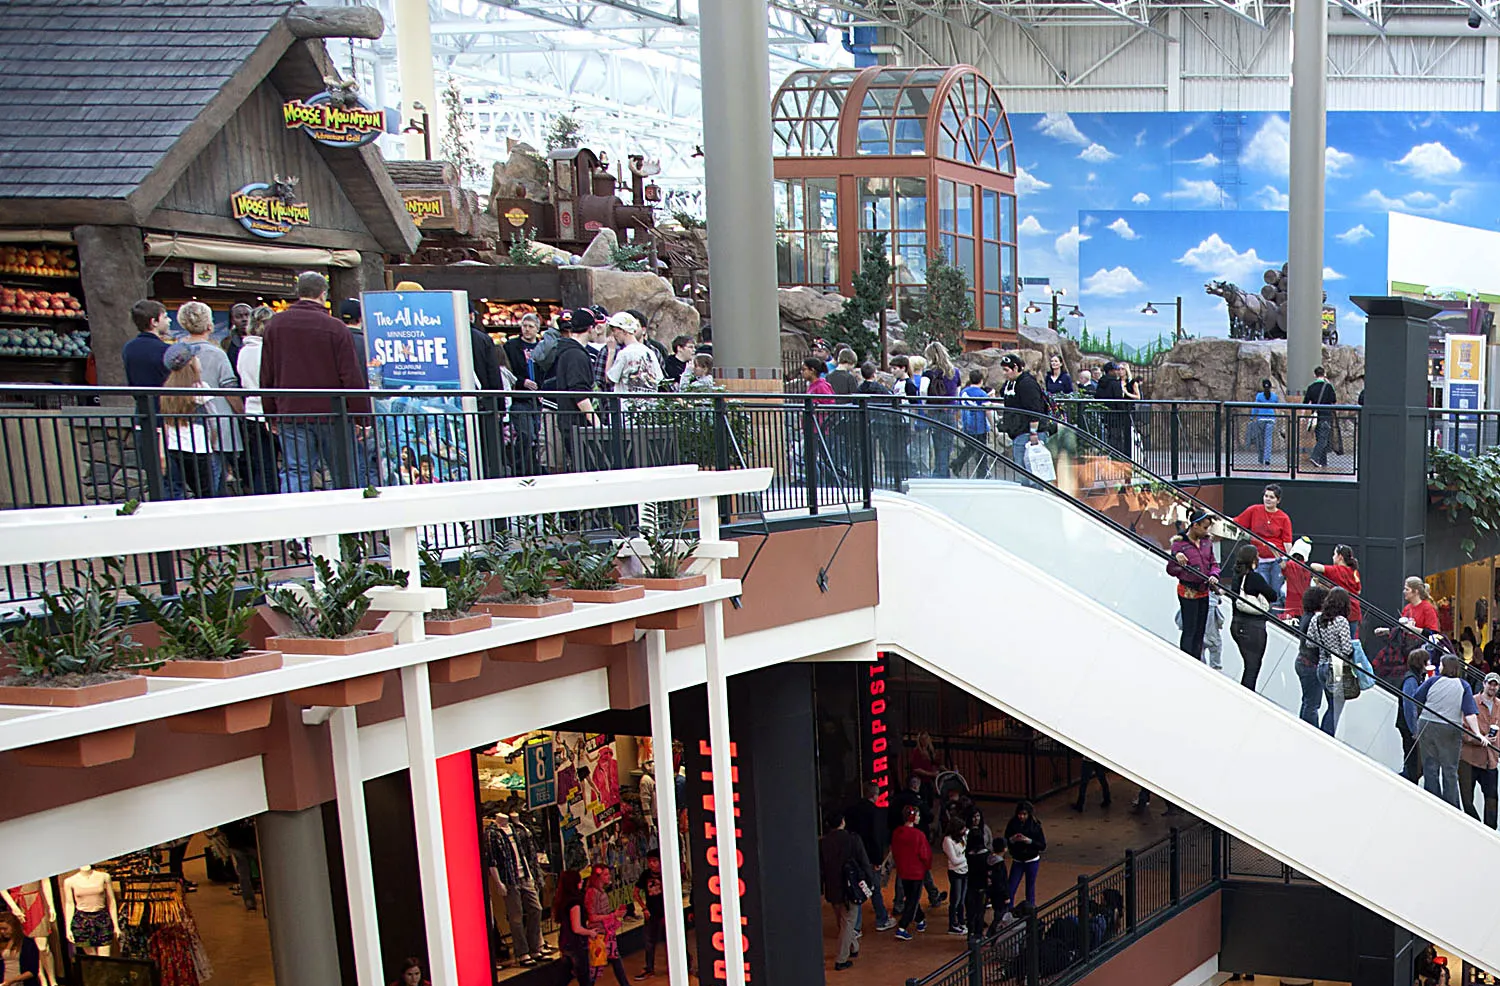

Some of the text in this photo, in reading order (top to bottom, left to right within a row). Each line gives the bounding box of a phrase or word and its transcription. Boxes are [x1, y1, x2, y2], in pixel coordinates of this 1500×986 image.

[284, 103, 381, 129] MOOSE MOUNTAIN
[238, 196, 309, 222] MOOSE MOUNTAIN
[373, 307, 441, 327] The All New
[386, 330, 426, 338] MINNESOTA
[374, 337, 406, 366] SEA
